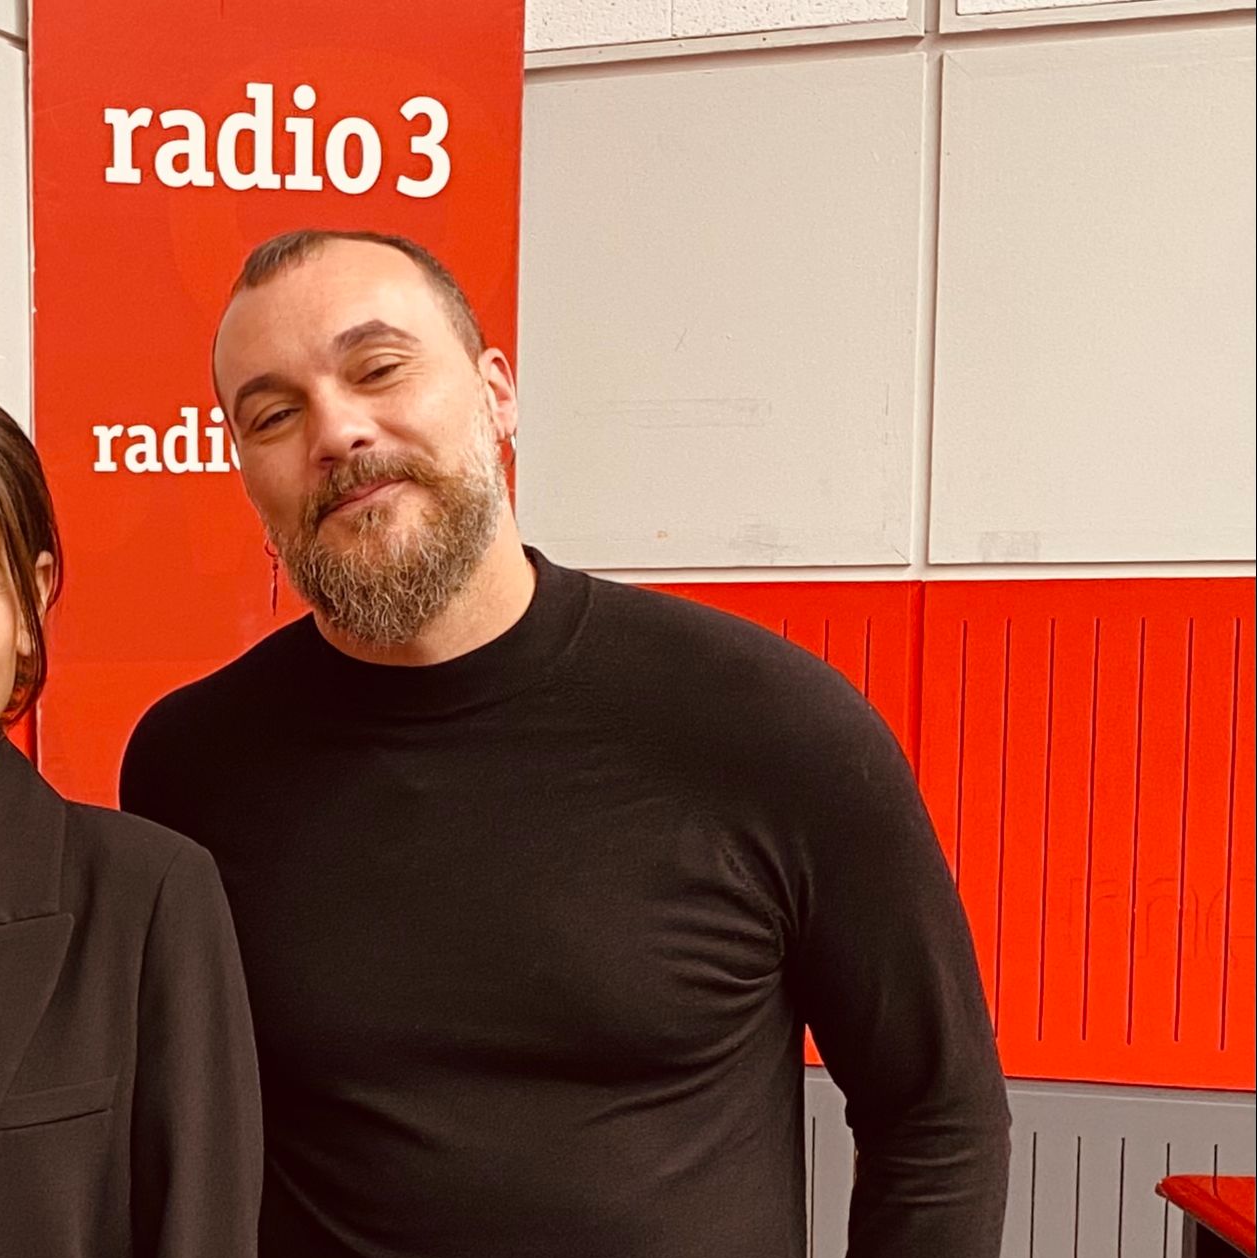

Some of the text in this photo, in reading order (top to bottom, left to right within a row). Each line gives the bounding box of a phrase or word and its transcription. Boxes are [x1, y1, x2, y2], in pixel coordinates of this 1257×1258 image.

[104, 82, 451, 198] radio 3
[92, 406, 241, 474] radi
